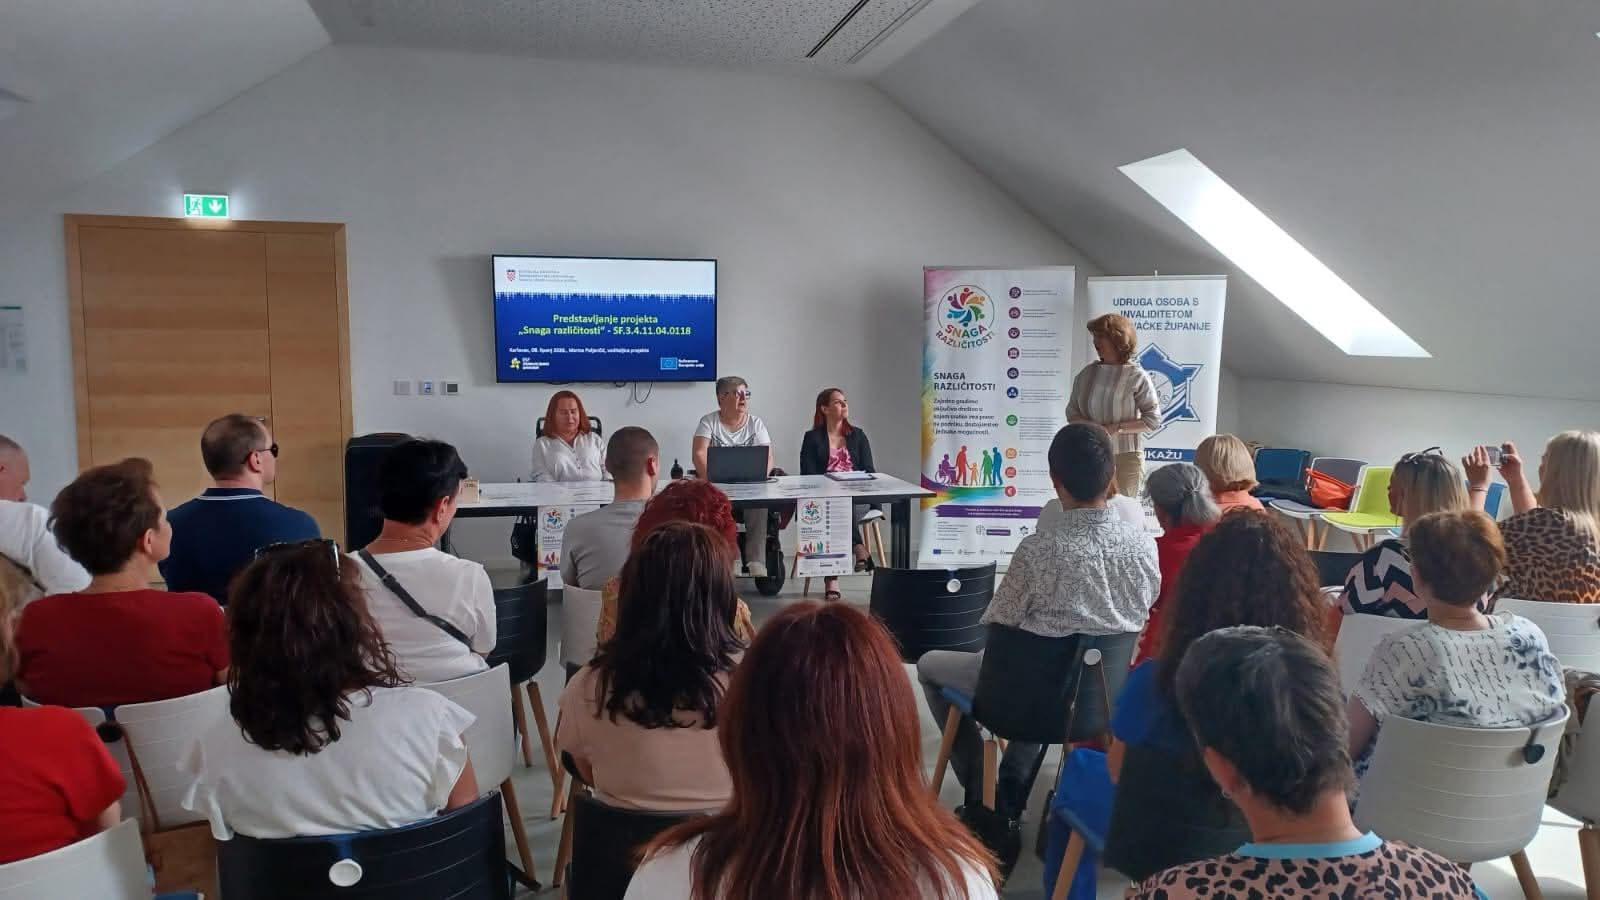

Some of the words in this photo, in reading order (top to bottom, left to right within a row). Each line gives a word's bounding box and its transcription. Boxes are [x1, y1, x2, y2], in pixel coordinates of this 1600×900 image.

[1113, 297, 1153, 306] UDRUGA
[1155, 297, 1190, 306] OSOBA
[1192, 297, 1199, 306] S
[1120, 310, 1193, 318] INVALIDITETOM
[553, 314, 618, 325] Predstavljanje
[621, 315, 658, 325] projekta
[945, 324, 987, 337] SNAGA
[1164, 321, 1211, 331] ŽUPANIJE
[936, 330, 995, 349] RAZLIČITOSTI
[934, 372, 966, 380] SNAGA
[934, 381, 996, 391] RAZLIČITOSTI
